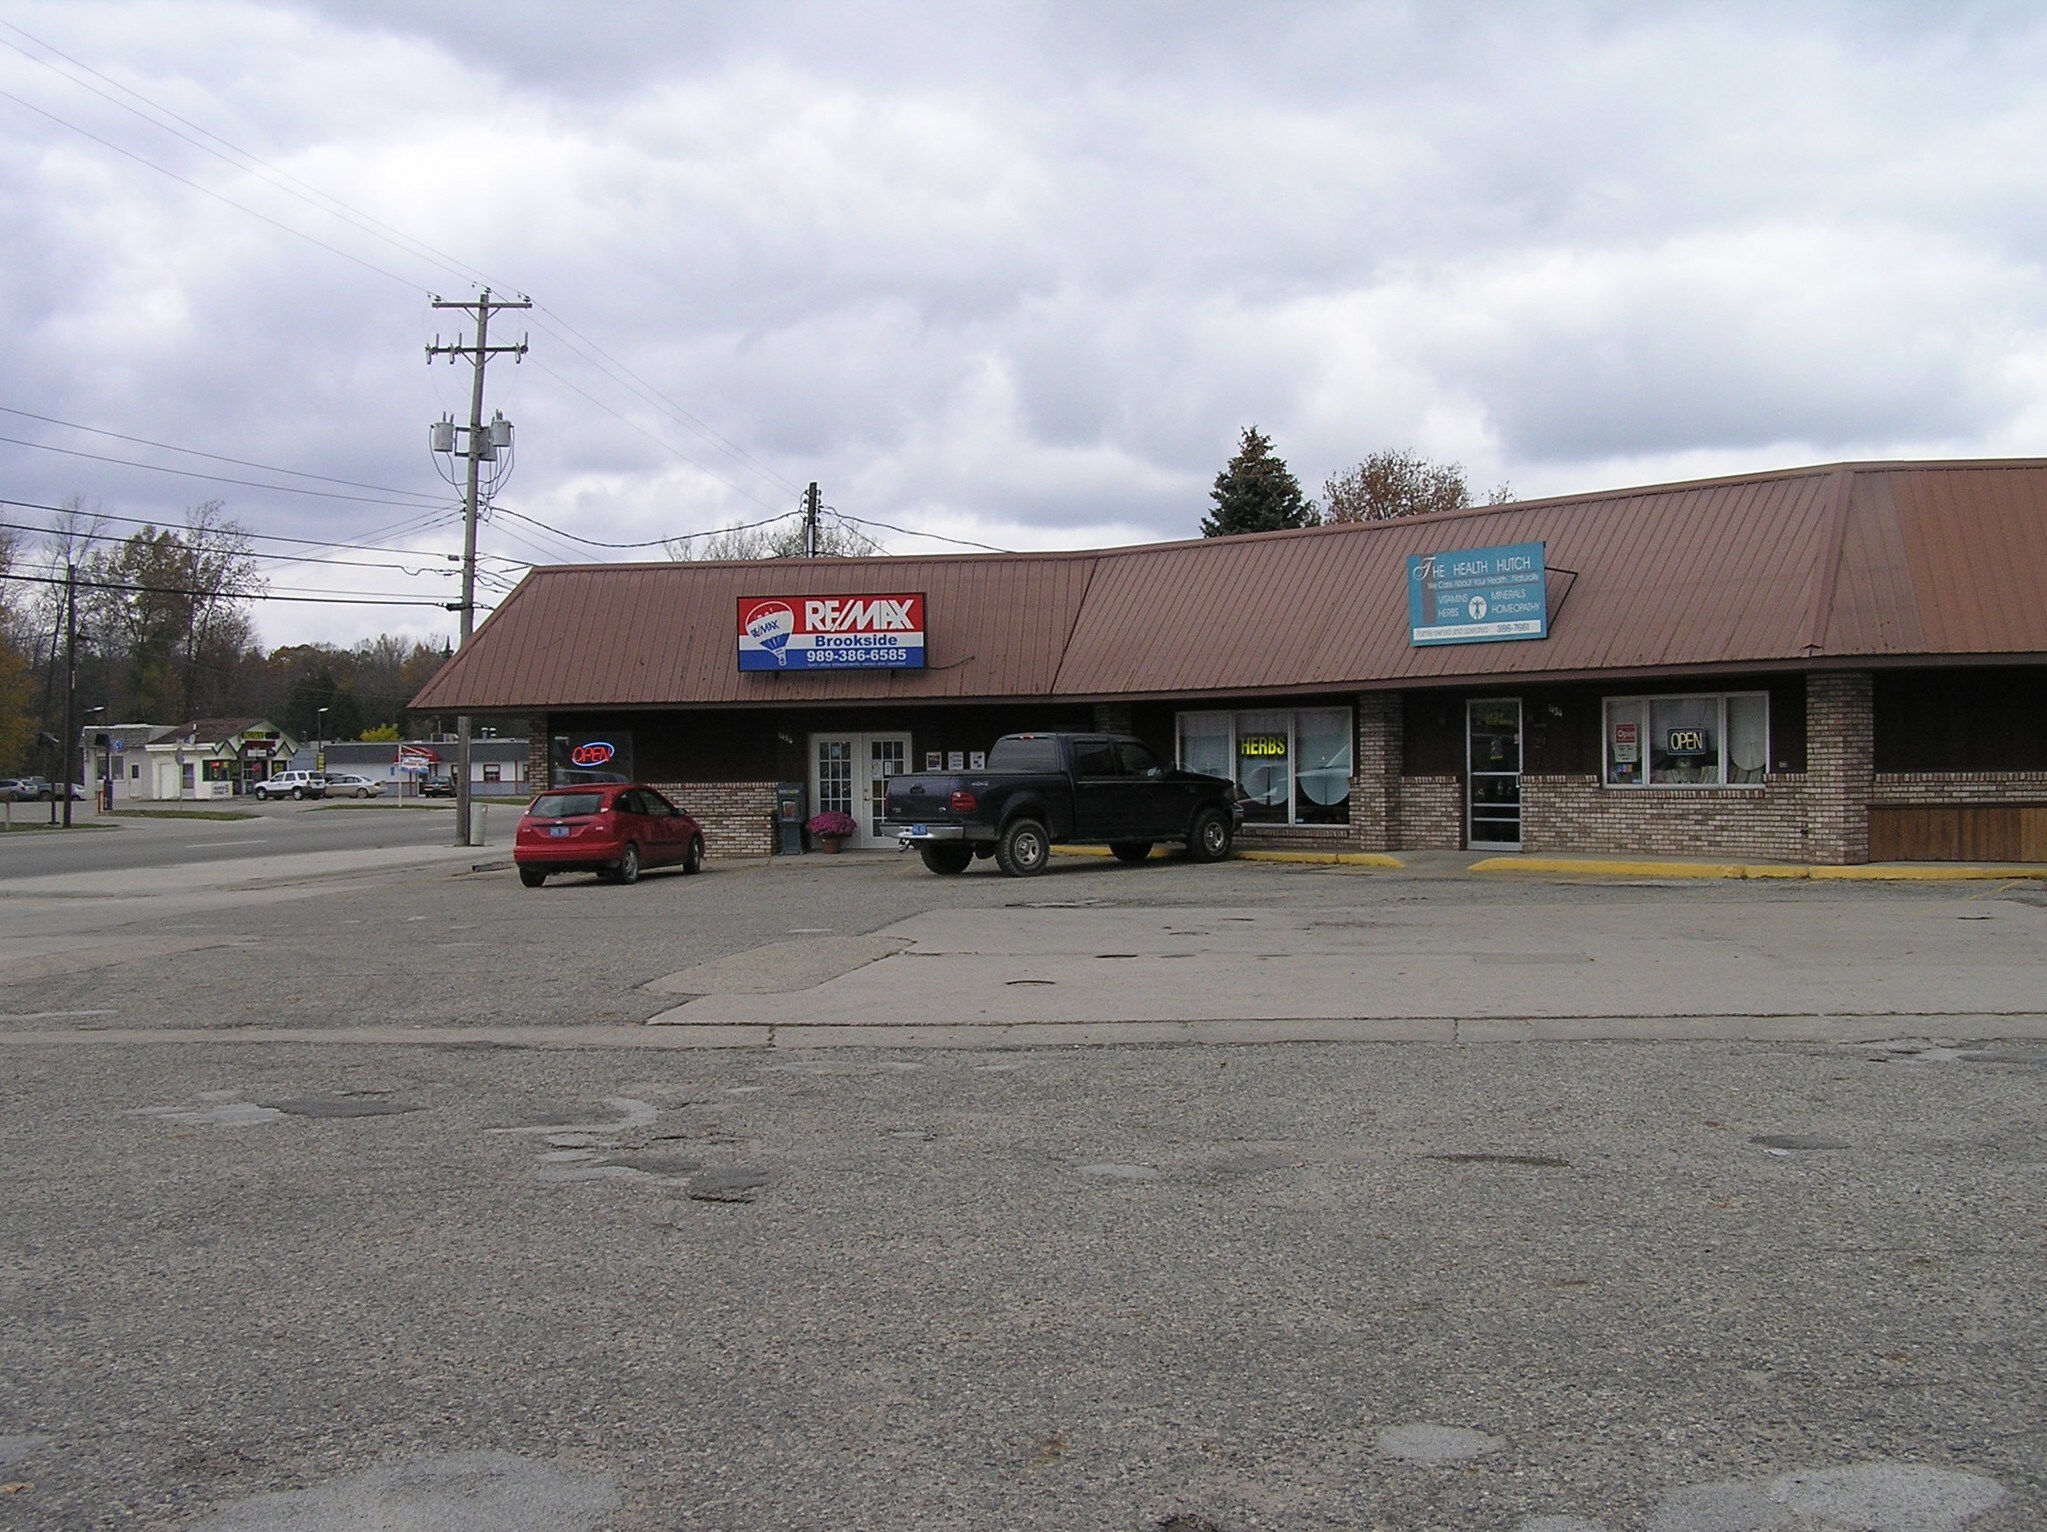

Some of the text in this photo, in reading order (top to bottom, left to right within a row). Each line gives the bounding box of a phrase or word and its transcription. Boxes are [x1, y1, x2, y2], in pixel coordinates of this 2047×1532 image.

[1453, 560, 1488, 576] HEALTH
[1496, 556, 1531, 571] HUTCH
[1454, 578, 1472, 588] About
[1437, 588, 1526, 604] VITAMINS MINERALS
[805, 599, 914, 632] RE/MAX
[1438, 602, 1540, 618] HERBS HOMEOPATHY
[815, 634, 897, 647] Brookside
[806, 649, 907, 662] 989-386-6585
[1241, 737, 1285, 755] HERBS
[1671, 732, 1703, 750] OPEN
[572, 746, 611, 763] OPEN
